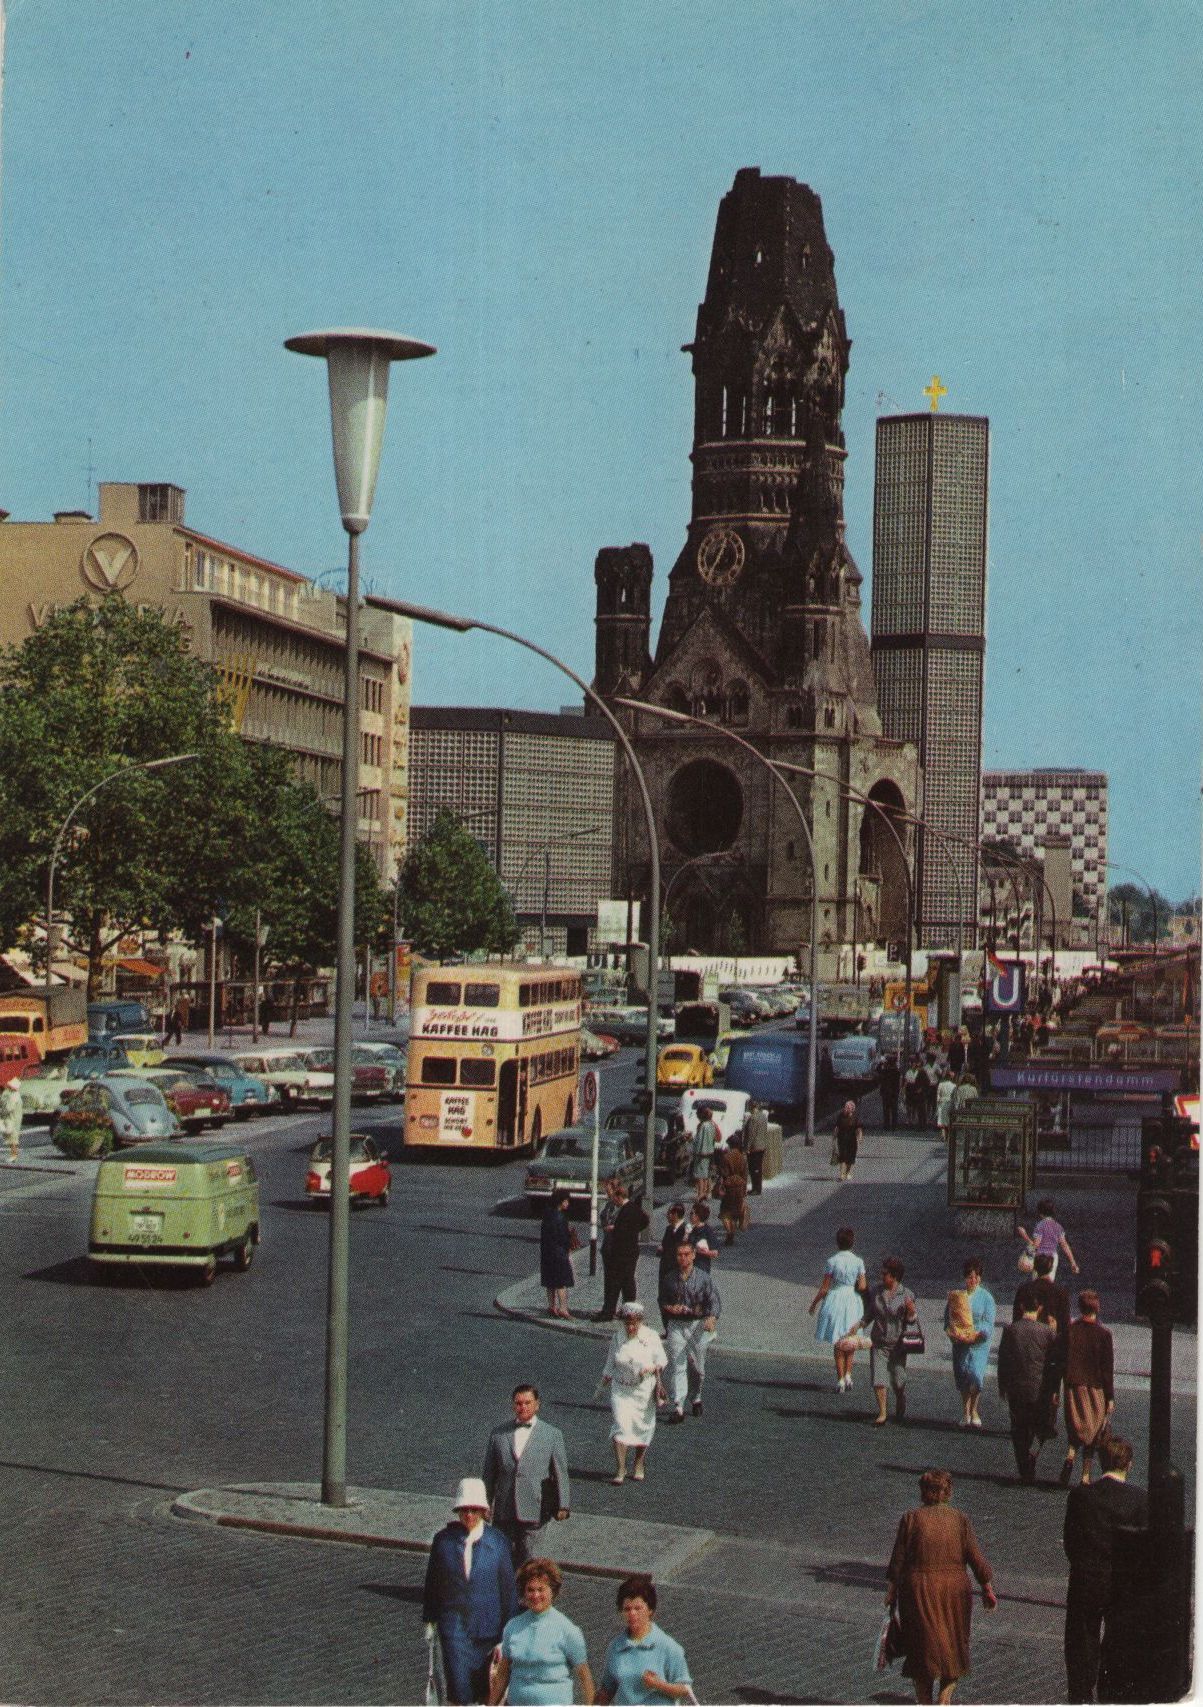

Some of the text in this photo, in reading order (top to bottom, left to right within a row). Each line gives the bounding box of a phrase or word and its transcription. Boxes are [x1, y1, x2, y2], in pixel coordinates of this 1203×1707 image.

[993, 967, 1019, 1006] U
[422, 1023, 499, 1038] KAFFEE HAG
